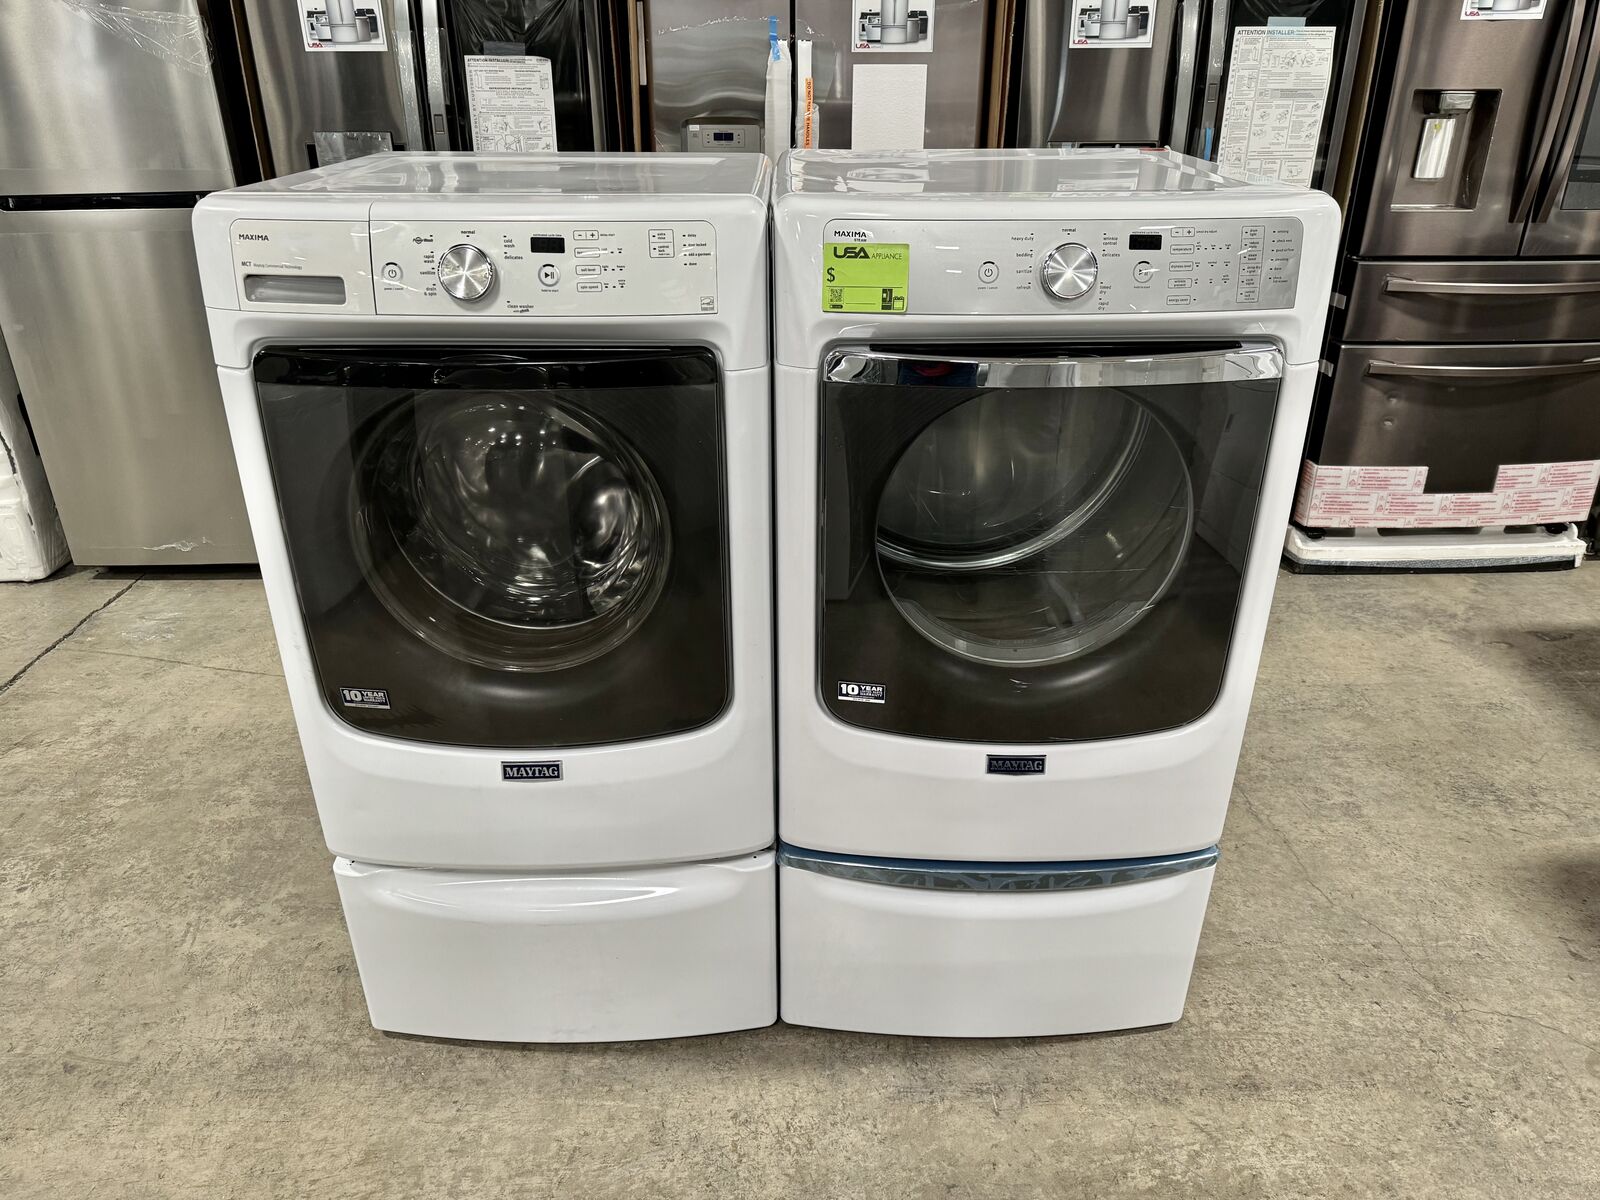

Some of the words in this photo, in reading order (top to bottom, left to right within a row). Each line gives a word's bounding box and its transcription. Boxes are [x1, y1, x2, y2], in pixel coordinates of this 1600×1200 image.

[238, 233, 269, 242] MAXIMA
[833, 246, 870, 259] USA
[827, 266, 835, 283] $
[841, 683, 859, 695] 10
[343, 690, 362, 701] 10
[991, 760, 1042, 771] MAYTAG
[505, 766, 558, 777] MAYTAG
